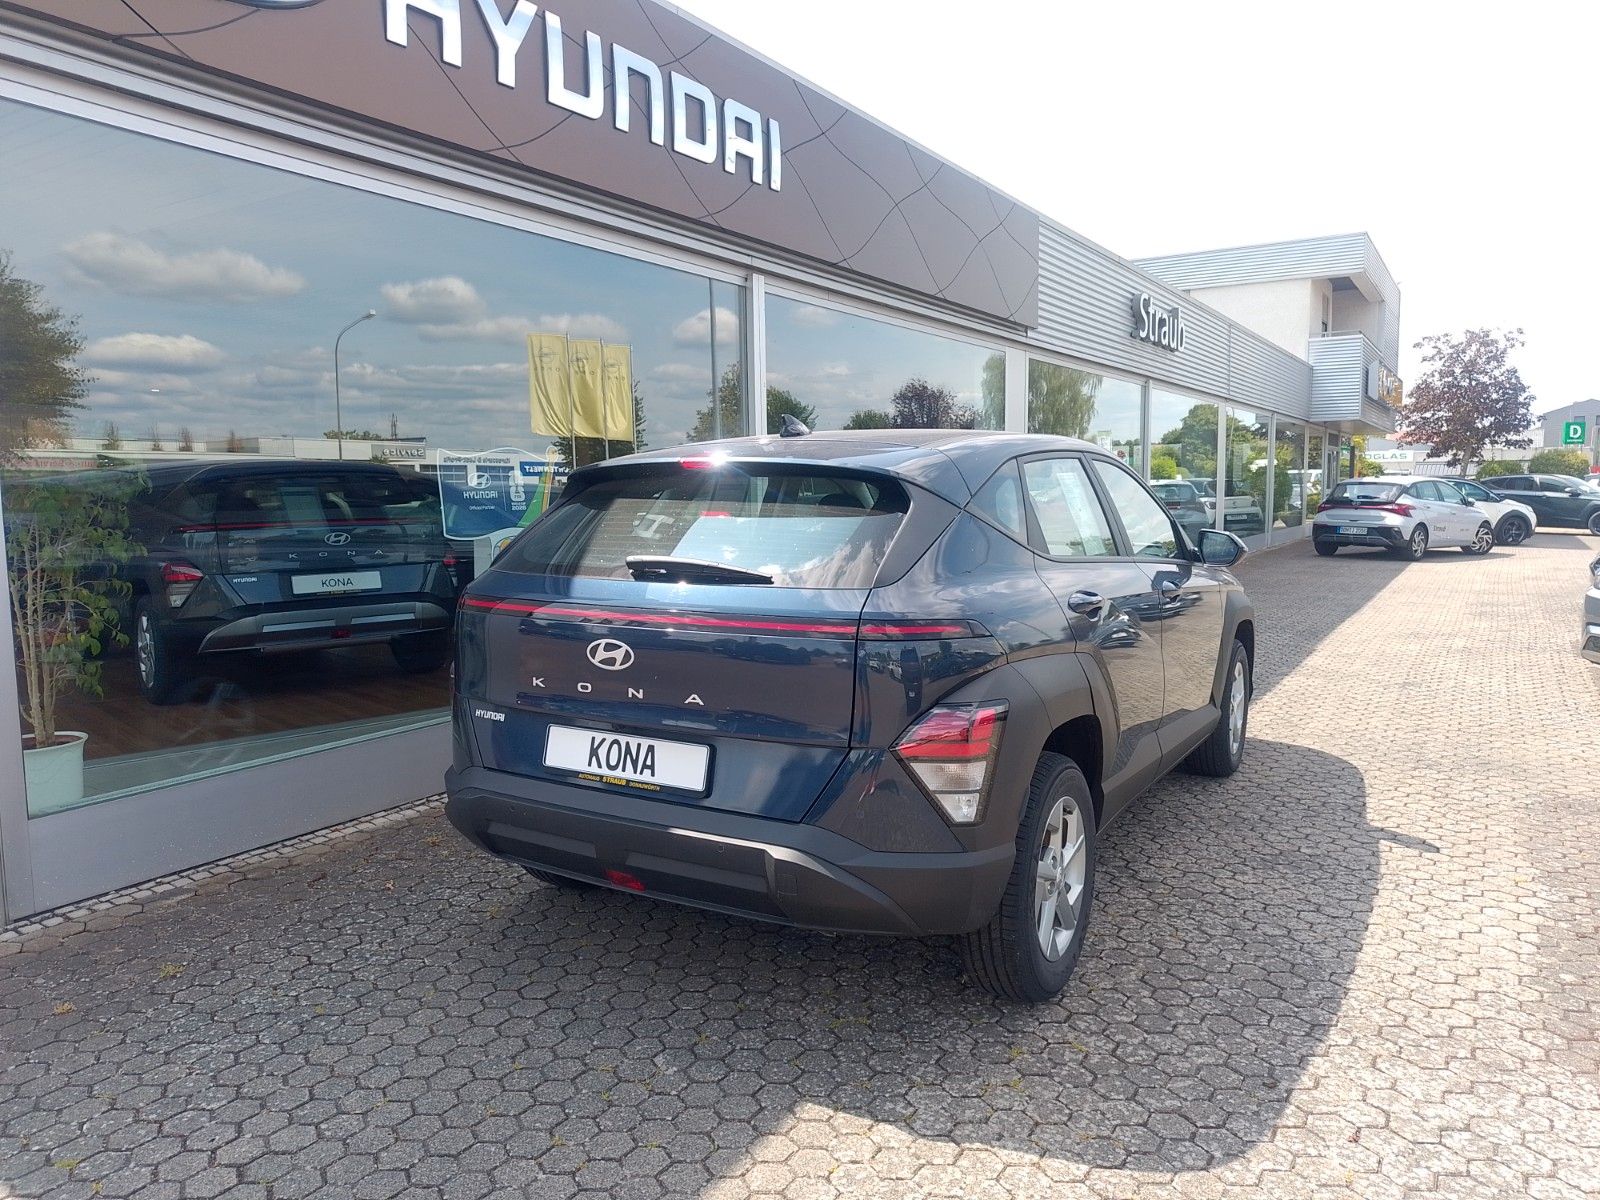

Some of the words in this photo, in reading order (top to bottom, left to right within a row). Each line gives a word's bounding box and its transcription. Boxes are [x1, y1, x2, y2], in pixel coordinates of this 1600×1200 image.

[1140, 293, 1186, 352] Straub
[1570, 425, 1582, 439] D
[463, 490, 498, 499] HYUNDAI
[289, 549, 384, 559] KONA
[321, 577, 354, 588] KONA
[532, 677, 705, 706] KONA
[475, 708, 505, 722] HYUNDAI
[587, 735, 656, 778] KONA
[602, 776, 627, 786] STRAUB
